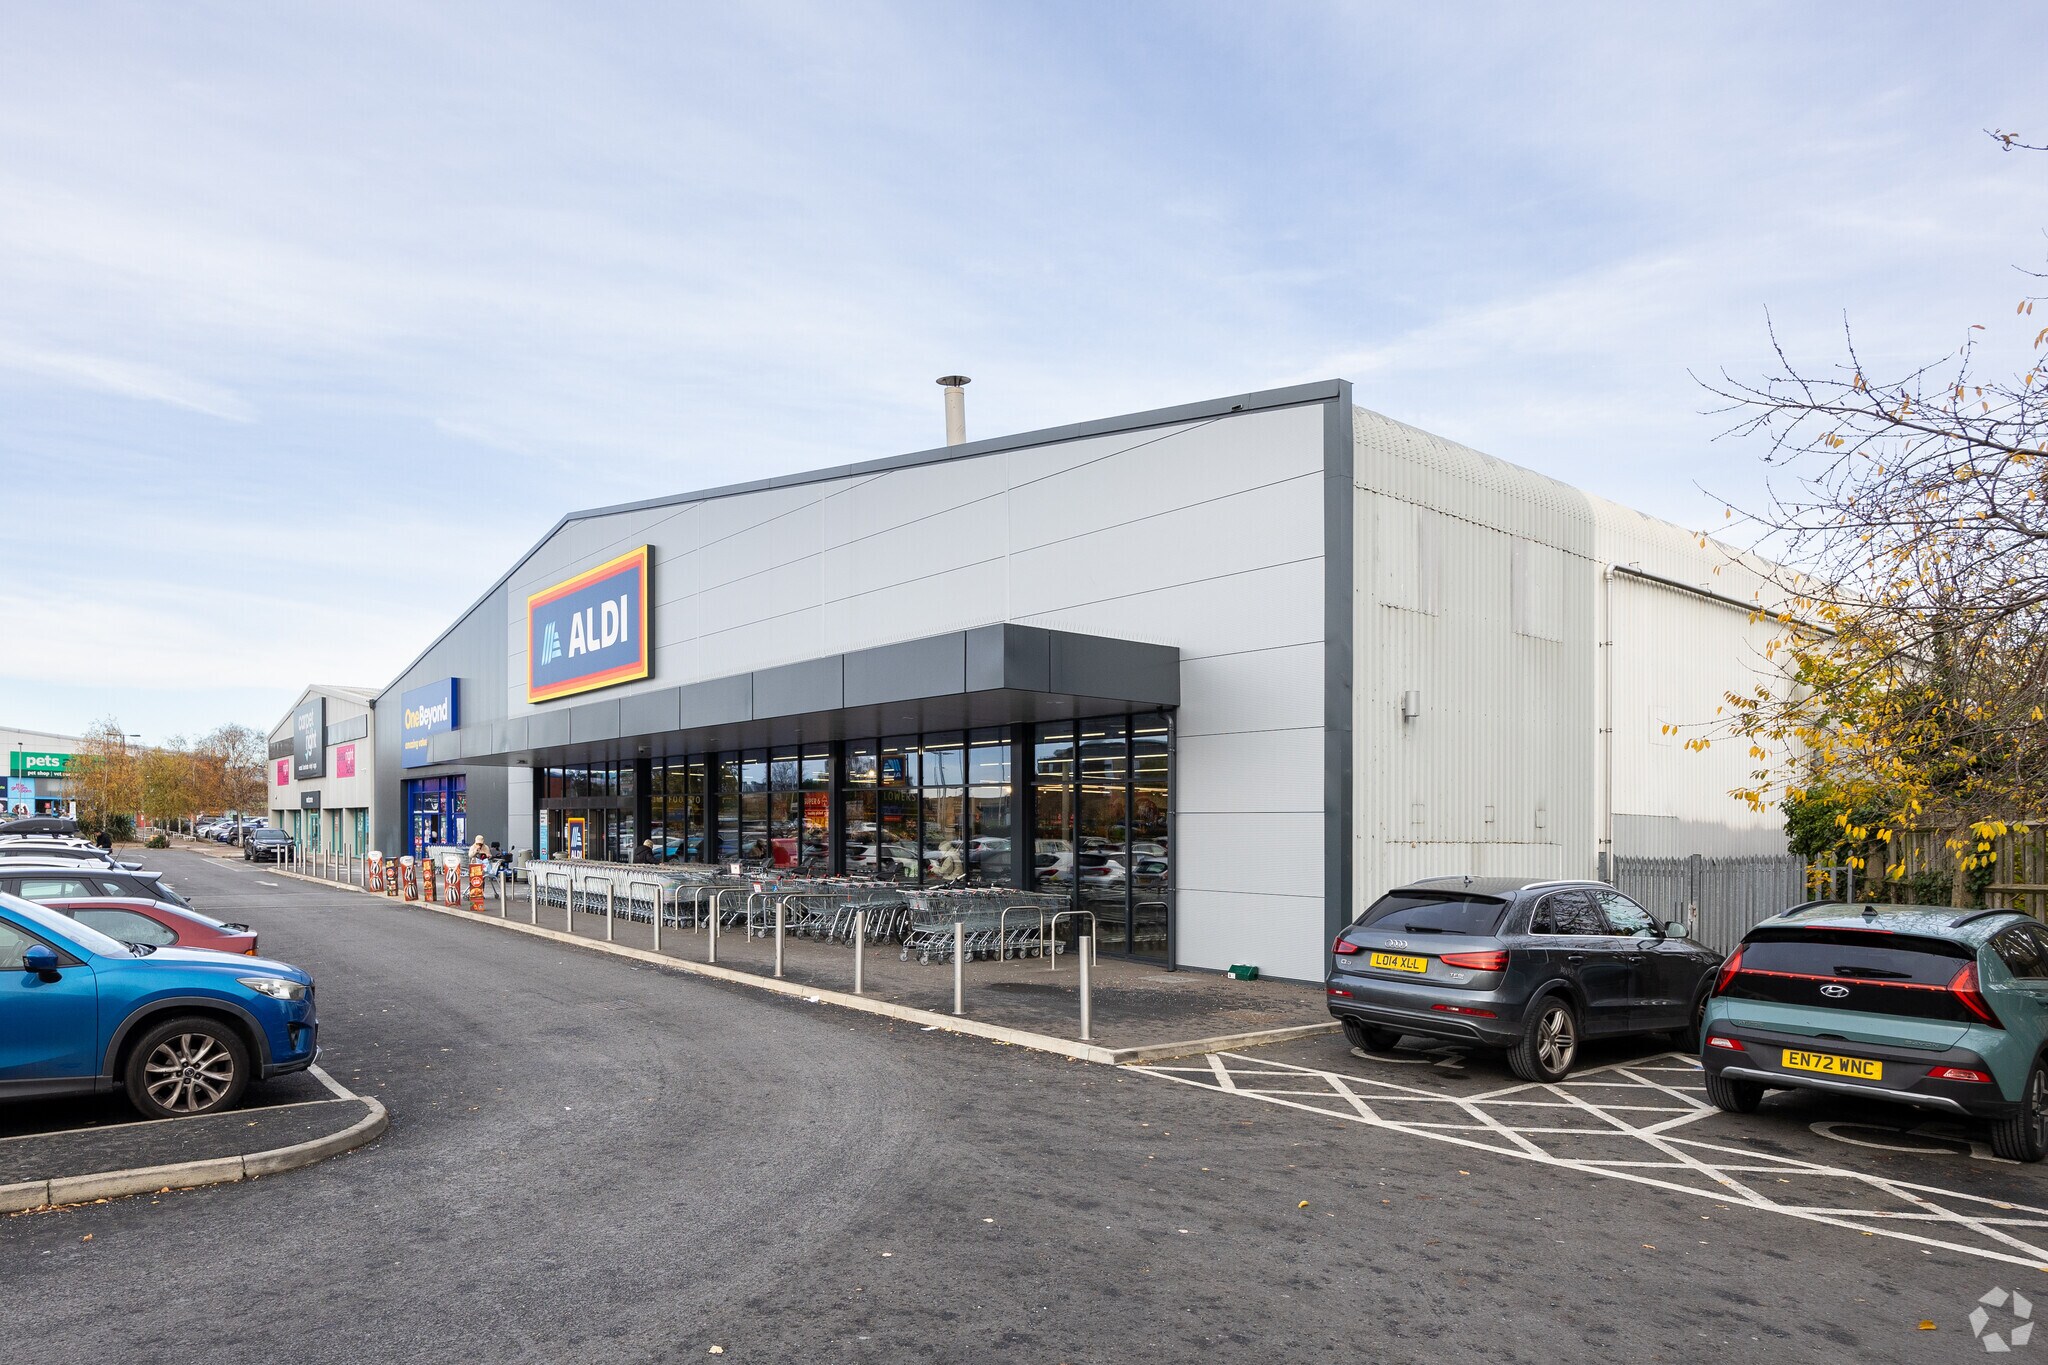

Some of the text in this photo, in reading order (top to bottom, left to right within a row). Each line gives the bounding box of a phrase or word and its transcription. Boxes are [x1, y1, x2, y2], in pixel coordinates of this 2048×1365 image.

[568, 593, 628, 658] ALDI
[405, 697, 448, 730] OneBeyond
[26, 755, 60, 768] pets
[883, 789, 917, 802] LOWERS
[571, 849, 583, 859] ALDI
[1376, 954, 1419, 969] LO14 XLL
[1788, 1051, 1874, 1076] EN72 WNC
